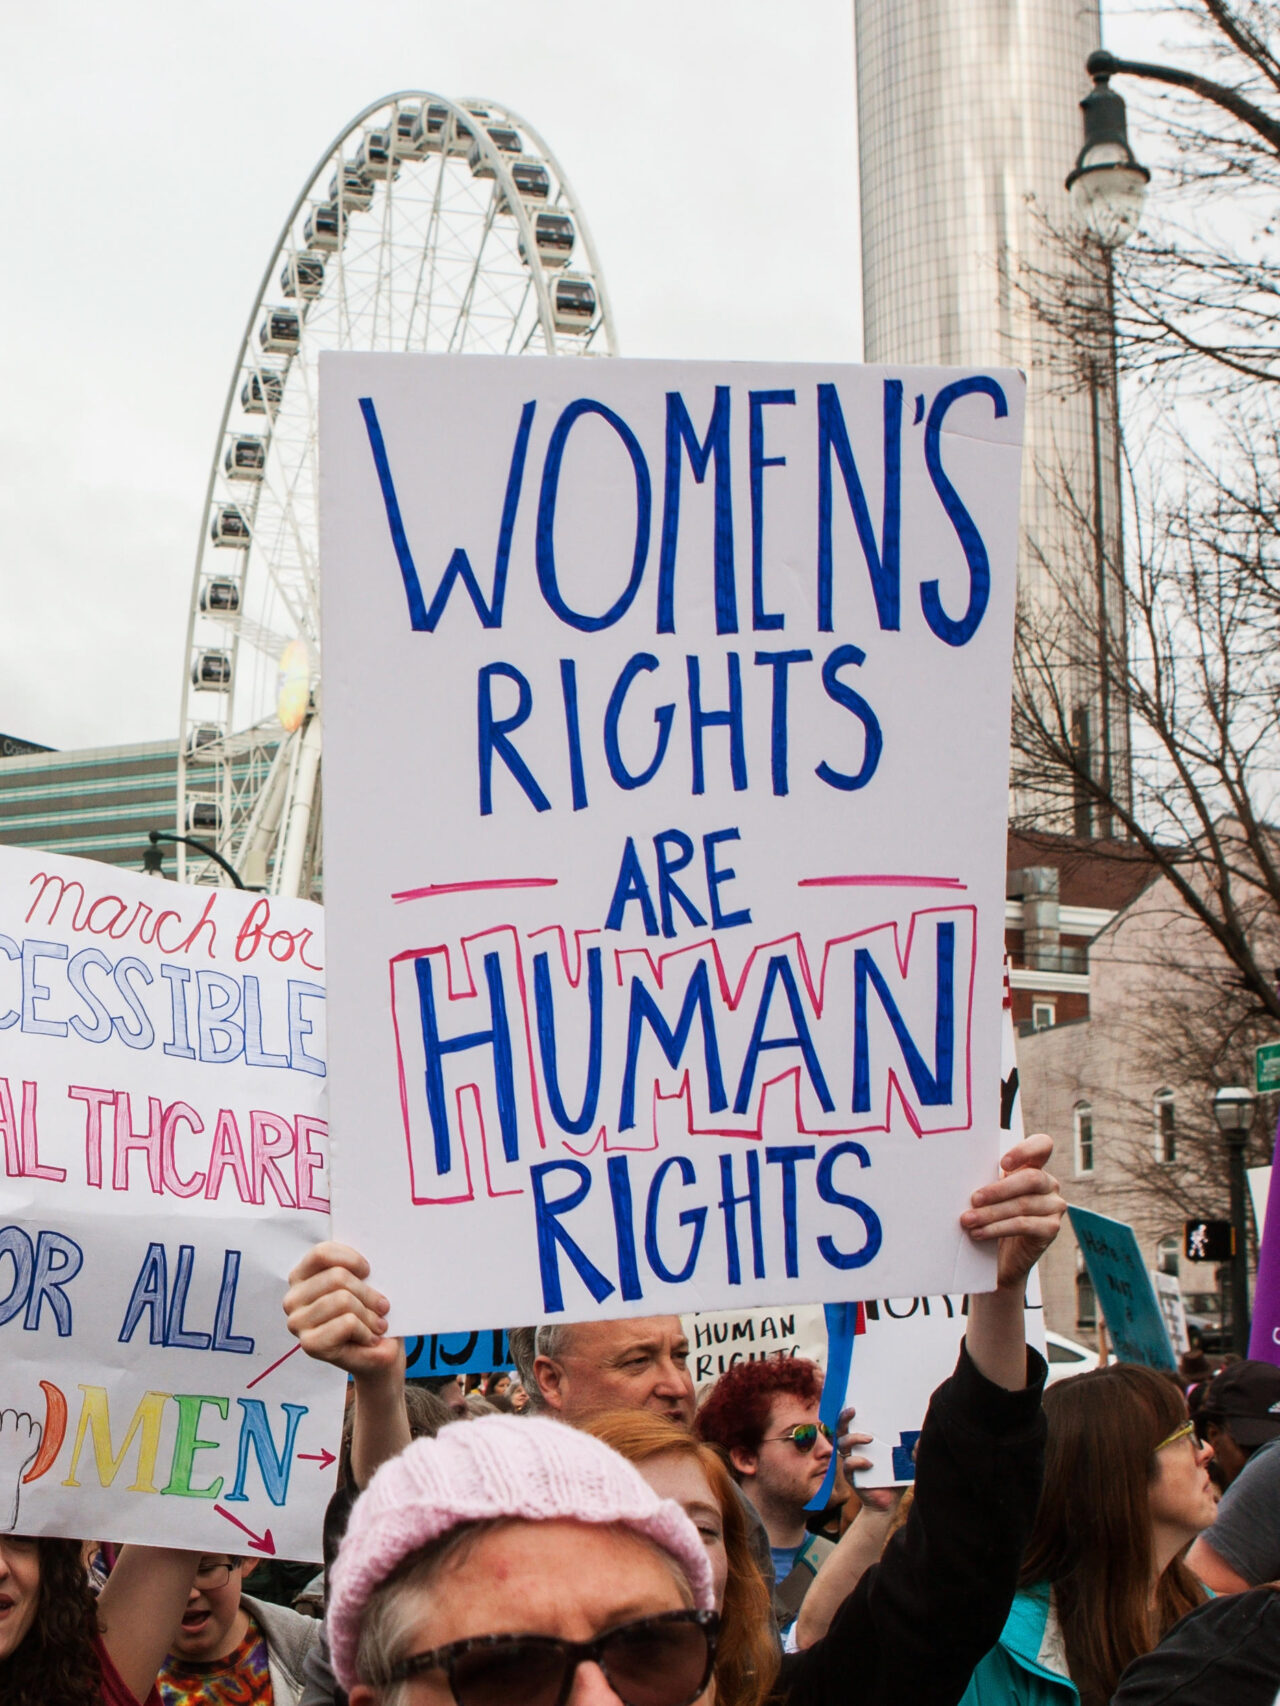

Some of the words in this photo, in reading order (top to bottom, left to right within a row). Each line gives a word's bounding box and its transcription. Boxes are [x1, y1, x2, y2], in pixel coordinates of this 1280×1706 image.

[358, 376, 1007, 646] WOMEN'S
[477, 645, 882, 815] RIGHTS
[26, 872, 217, 958] march
[235, 898, 323, 971] for
[604, 827, 752, 937] ARE
[390, 905, 976, 1205] HUMAN
[530, 1141, 882, 1313] RIGHTS
[119, 1243, 254, 1354] ALL
[694, 1314, 795, 1349] HUMAN
